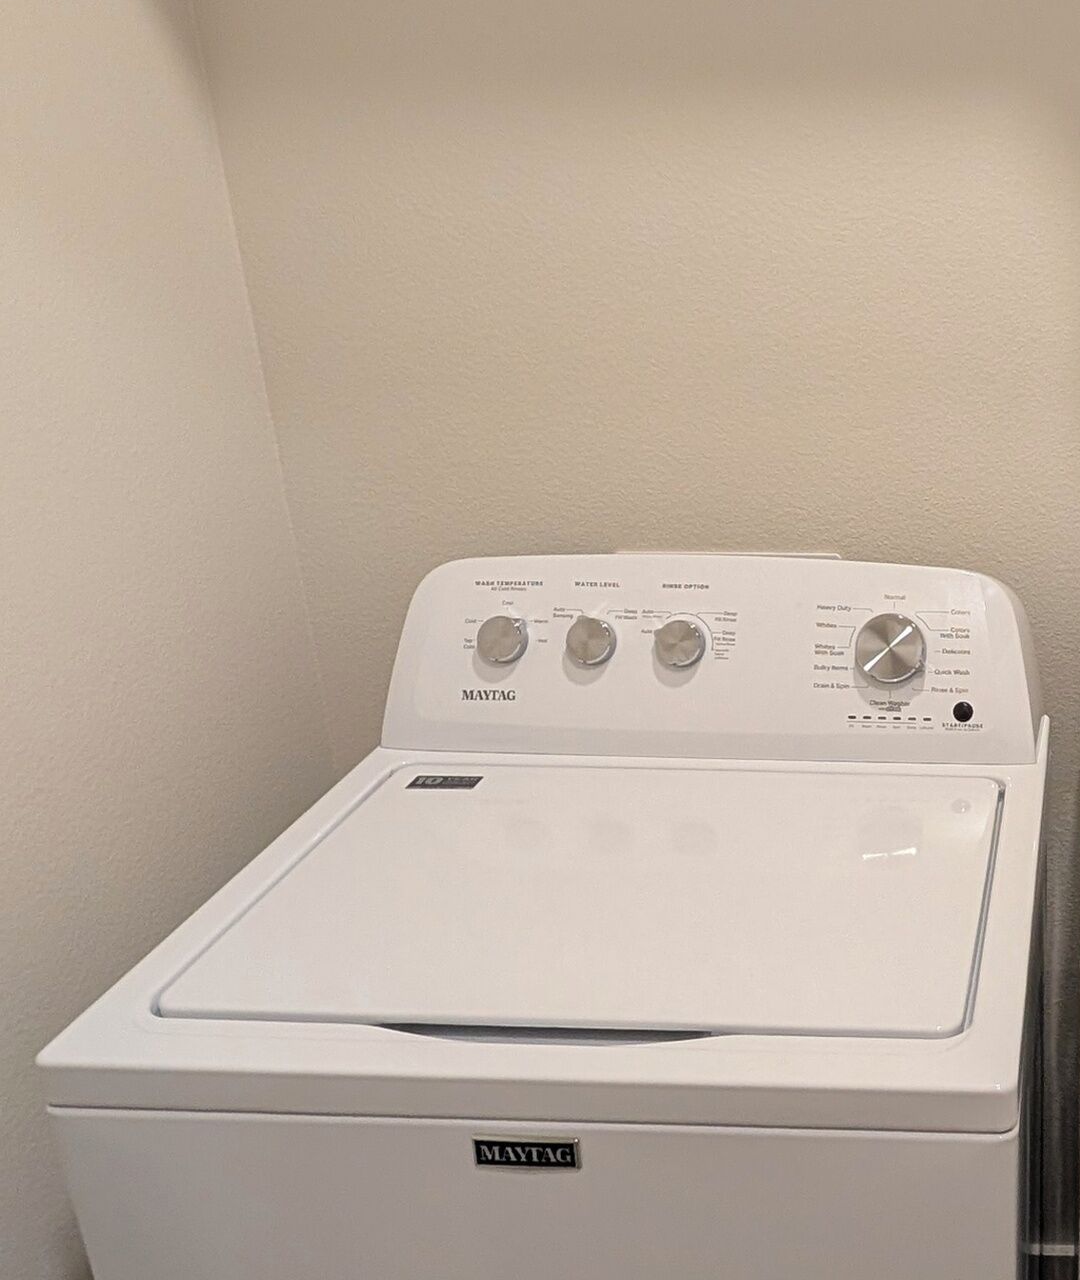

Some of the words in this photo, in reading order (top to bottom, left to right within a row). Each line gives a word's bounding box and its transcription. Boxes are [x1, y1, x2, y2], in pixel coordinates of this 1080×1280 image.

[837, 604, 852, 613] Duty
[461, 689, 516, 701] MAYTAG
[415, 776, 444, 785] 10
[479, 1145, 572, 1163] MAYTAG
